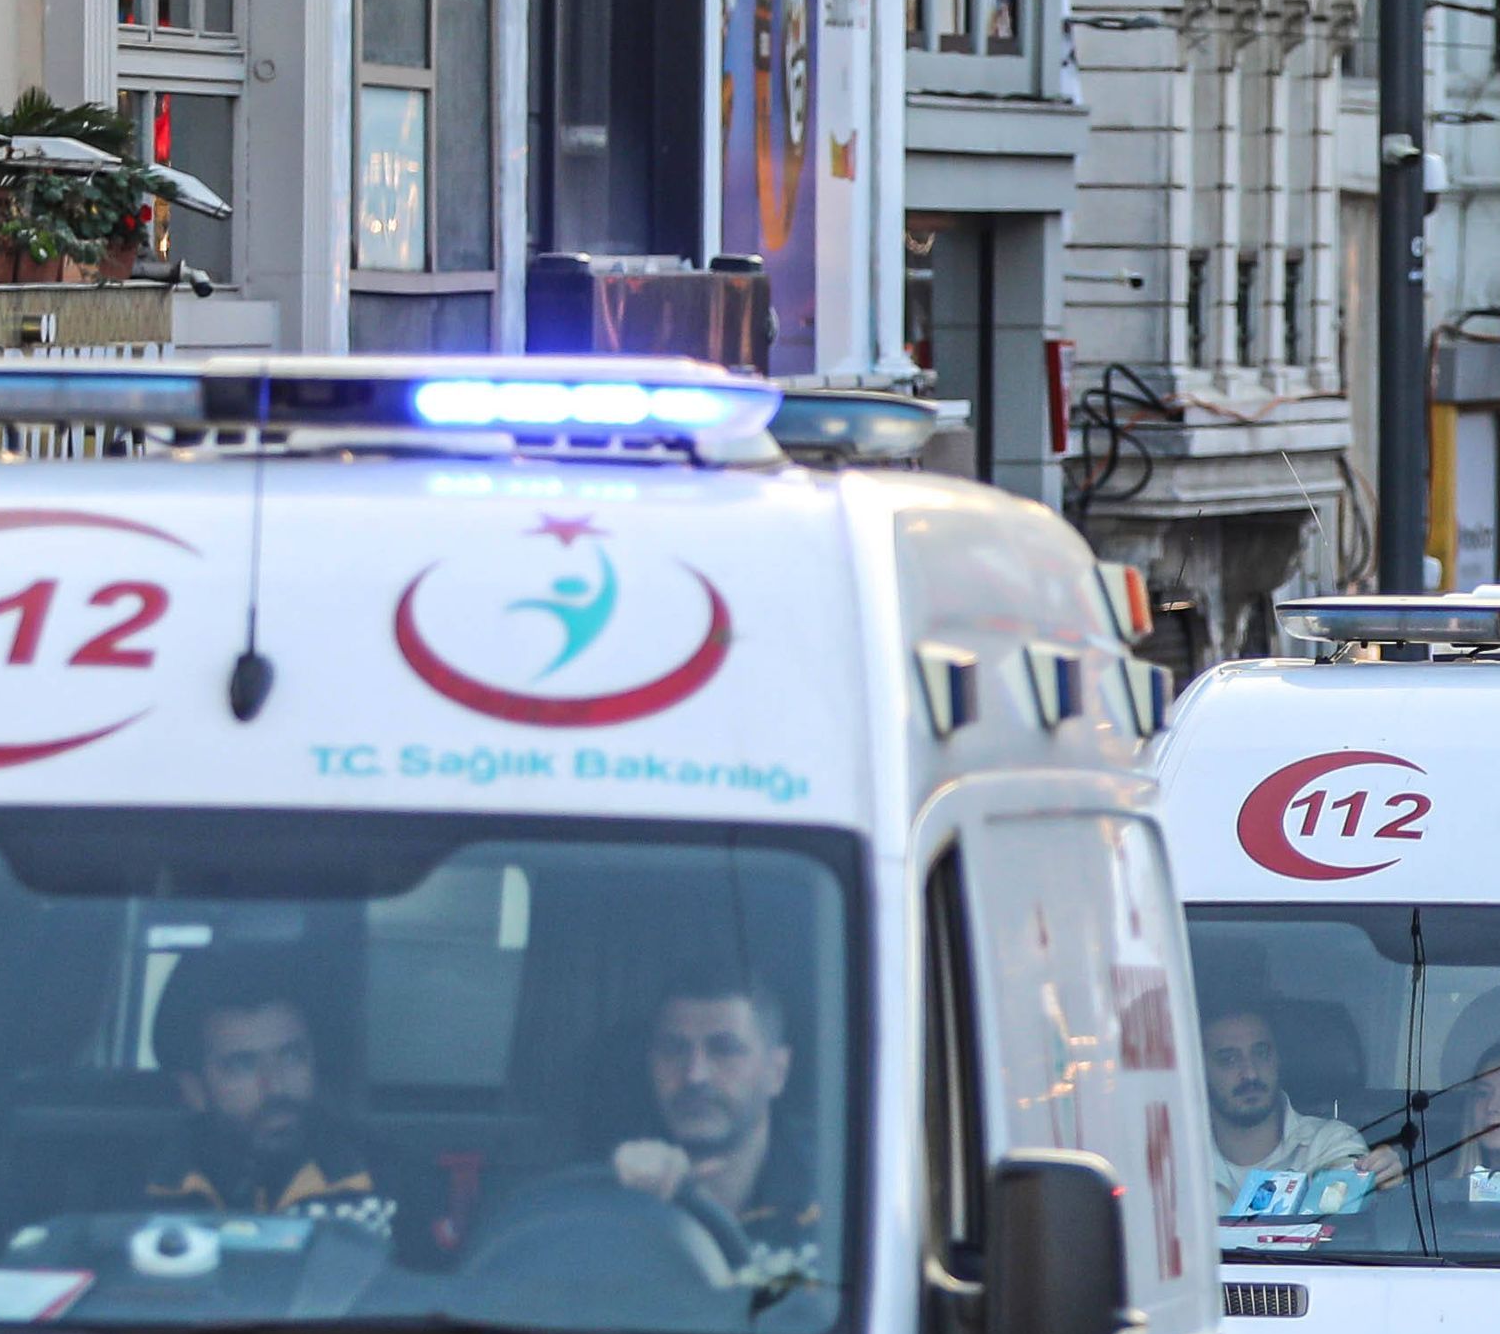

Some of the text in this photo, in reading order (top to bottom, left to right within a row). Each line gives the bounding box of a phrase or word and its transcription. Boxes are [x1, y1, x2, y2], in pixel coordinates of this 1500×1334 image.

[398, 744, 554, 785] Sağlık
[573, 747, 811, 802] Bakanlığı
[1290, 789, 1432, 841] 112
